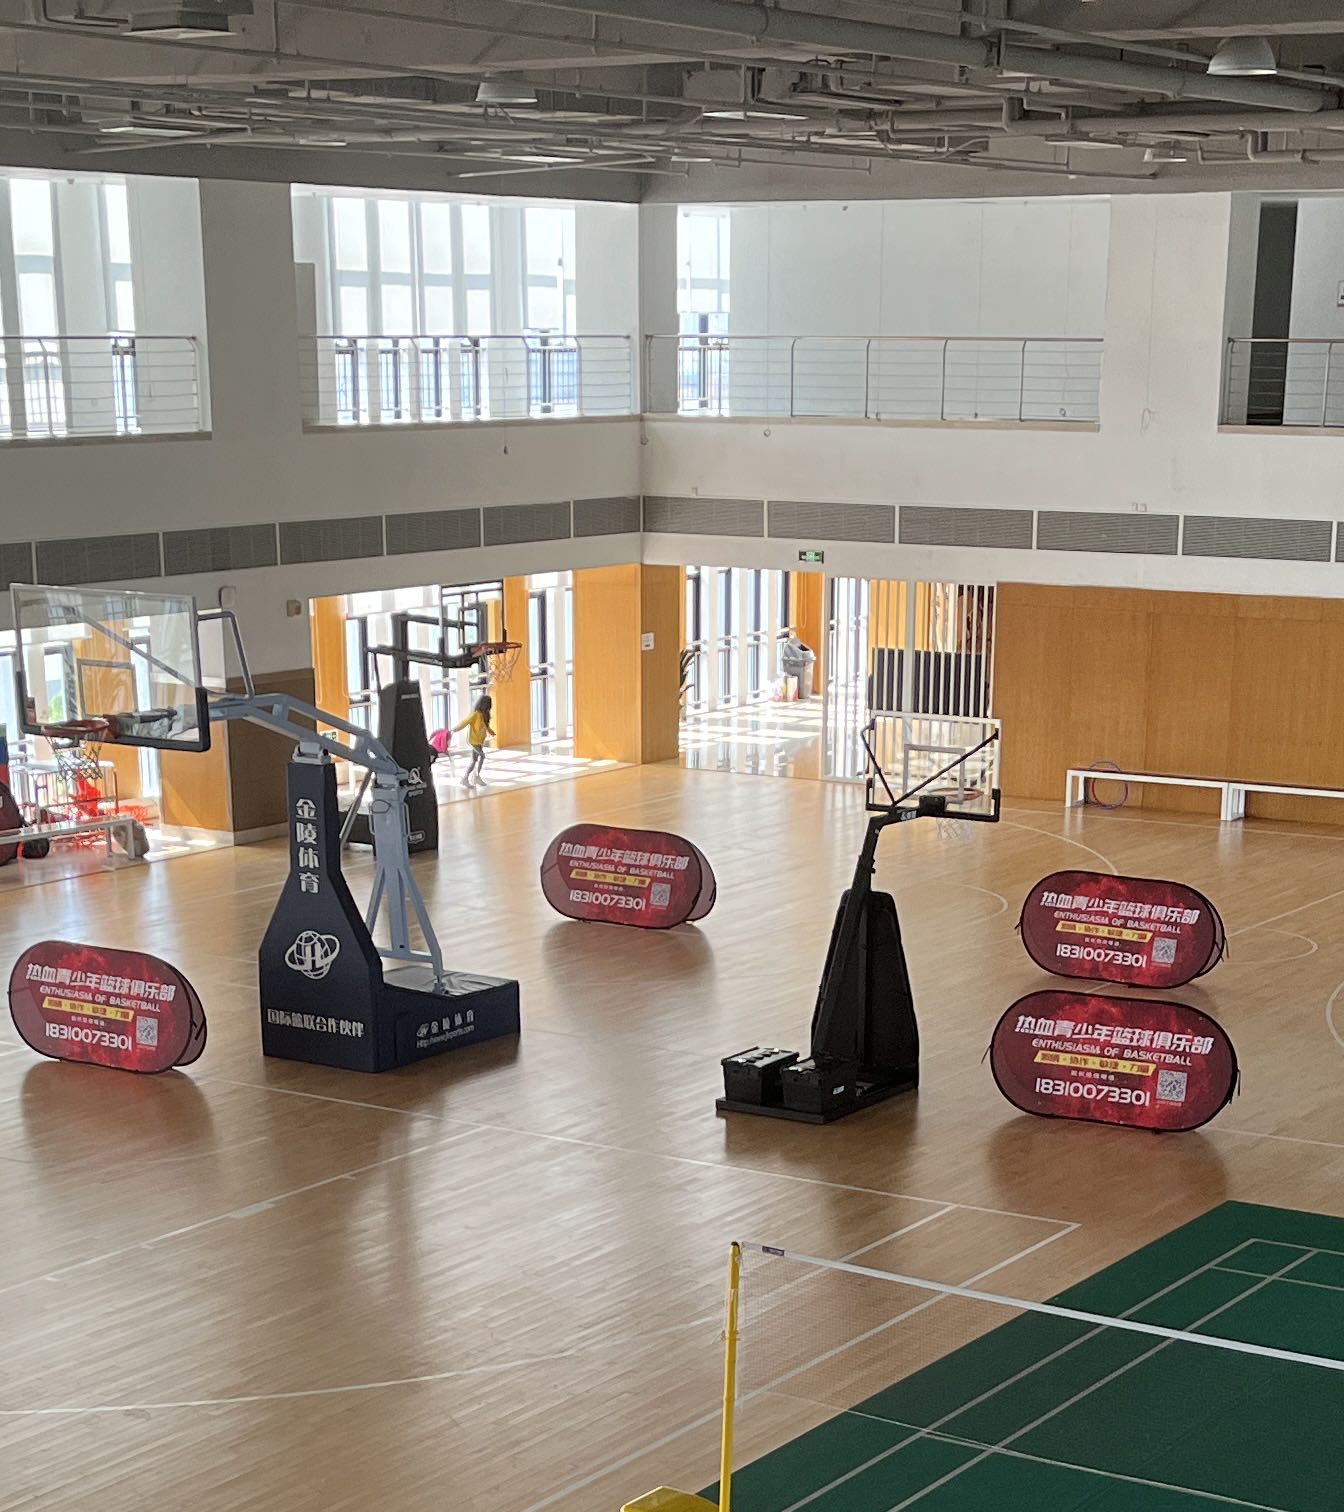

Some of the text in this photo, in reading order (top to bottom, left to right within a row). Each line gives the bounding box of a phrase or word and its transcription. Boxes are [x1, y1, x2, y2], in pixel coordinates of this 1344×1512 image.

[559, 842, 690, 870] 热血青少年篮球俱乐部
[617, 866, 627, 874] OF
[629, 867, 675, 879] BASKETBALL
[569, 889, 646, 911] 18310073301
[1040, 891, 1200, 925] 热血青少年篮球俱乐部
[1111, 917, 1124, 927] OF
[1126, 920, 1181, 934] BASKETBALL
[1056, 943, 1147, 968] 18310073301
[26, 963, 176, 1002] 热血青少年篮球俱乐部
[95, 994, 106, 1003] OF
[109, 996, 161, 1012] BASKETBALL
[45, 1022, 132, 1050] 18310073301
[1015, 1015, 1214, 1055] 热血青少年篮球俱乐部
[1032, 1038, 1101, 1055] ENTHUSIASM
[1104, 1047, 1118, 1058] OF
[1123, 1049, 1192, 1066] BASKETBALL
[1035, 1077, 1151, 1107] 18310073301
